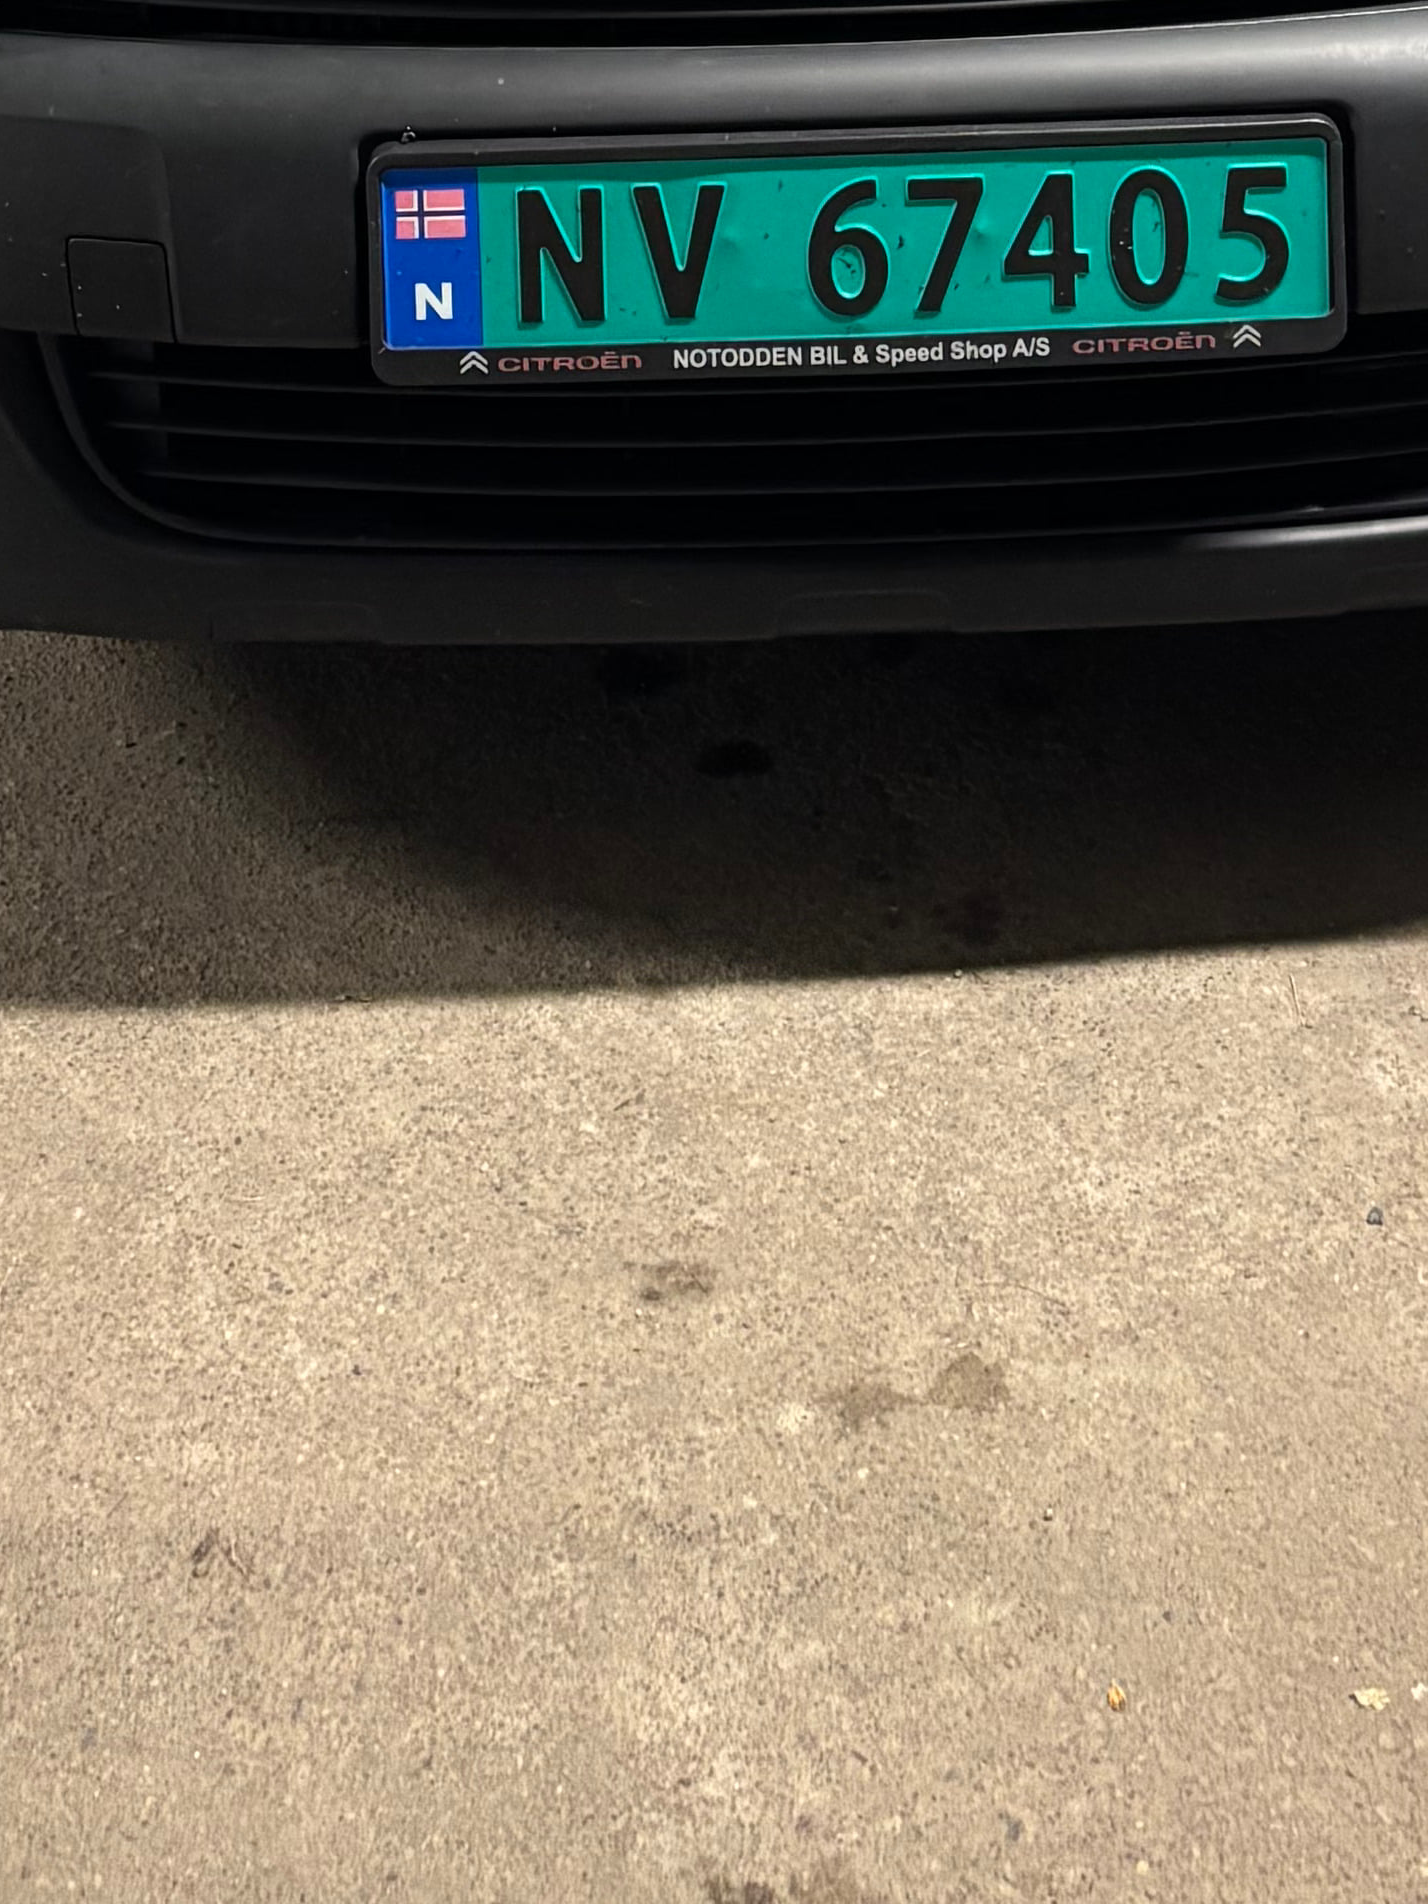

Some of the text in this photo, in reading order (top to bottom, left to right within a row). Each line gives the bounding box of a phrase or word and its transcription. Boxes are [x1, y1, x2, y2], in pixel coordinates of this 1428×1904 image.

[515, 161, 1291, 324] NV 67405
[414, 282, 454, 321] N
[673, 346, 803, 369] NOTODDEN
[809, 344, 847, 366] BIL
[852, 344, 869, 364] &
[875, 341, 944, 367] Speed
[949, 339, 1007, 363] Shop
[1011, 336, 1051, 357] A/S
